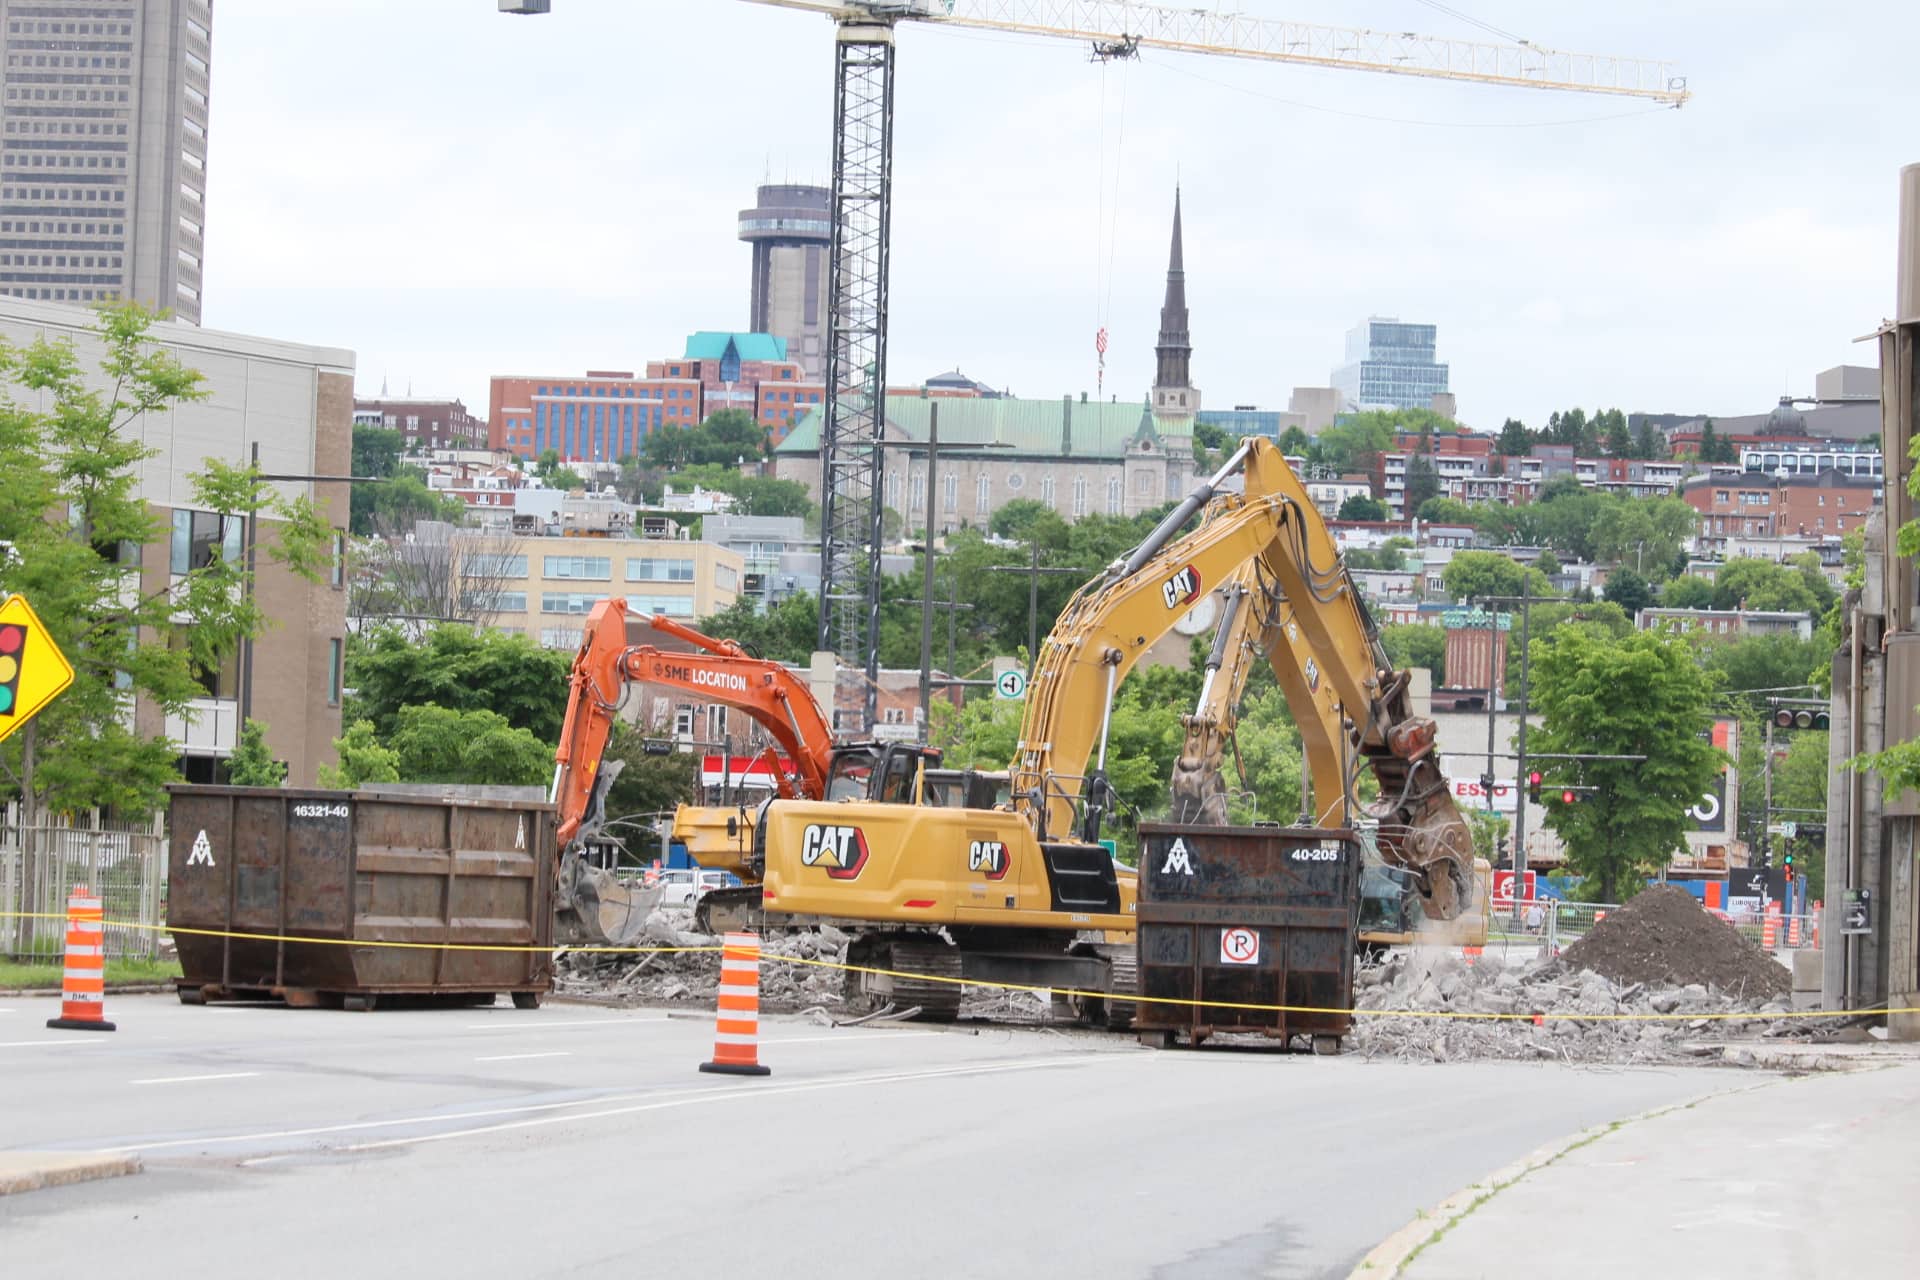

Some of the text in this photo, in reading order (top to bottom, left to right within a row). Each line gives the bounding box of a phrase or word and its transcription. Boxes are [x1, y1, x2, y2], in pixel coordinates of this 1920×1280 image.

[1162, 567, 1193, 609] CAT
[664, 664, 746, 691] SME LOCATION
[294, 805, 349, 817] 16321-40
[803, 824, 855, 868] CAT
[970, 841, 1002, 872] CAT
[1291, 848, 1338, 861] 40-205
